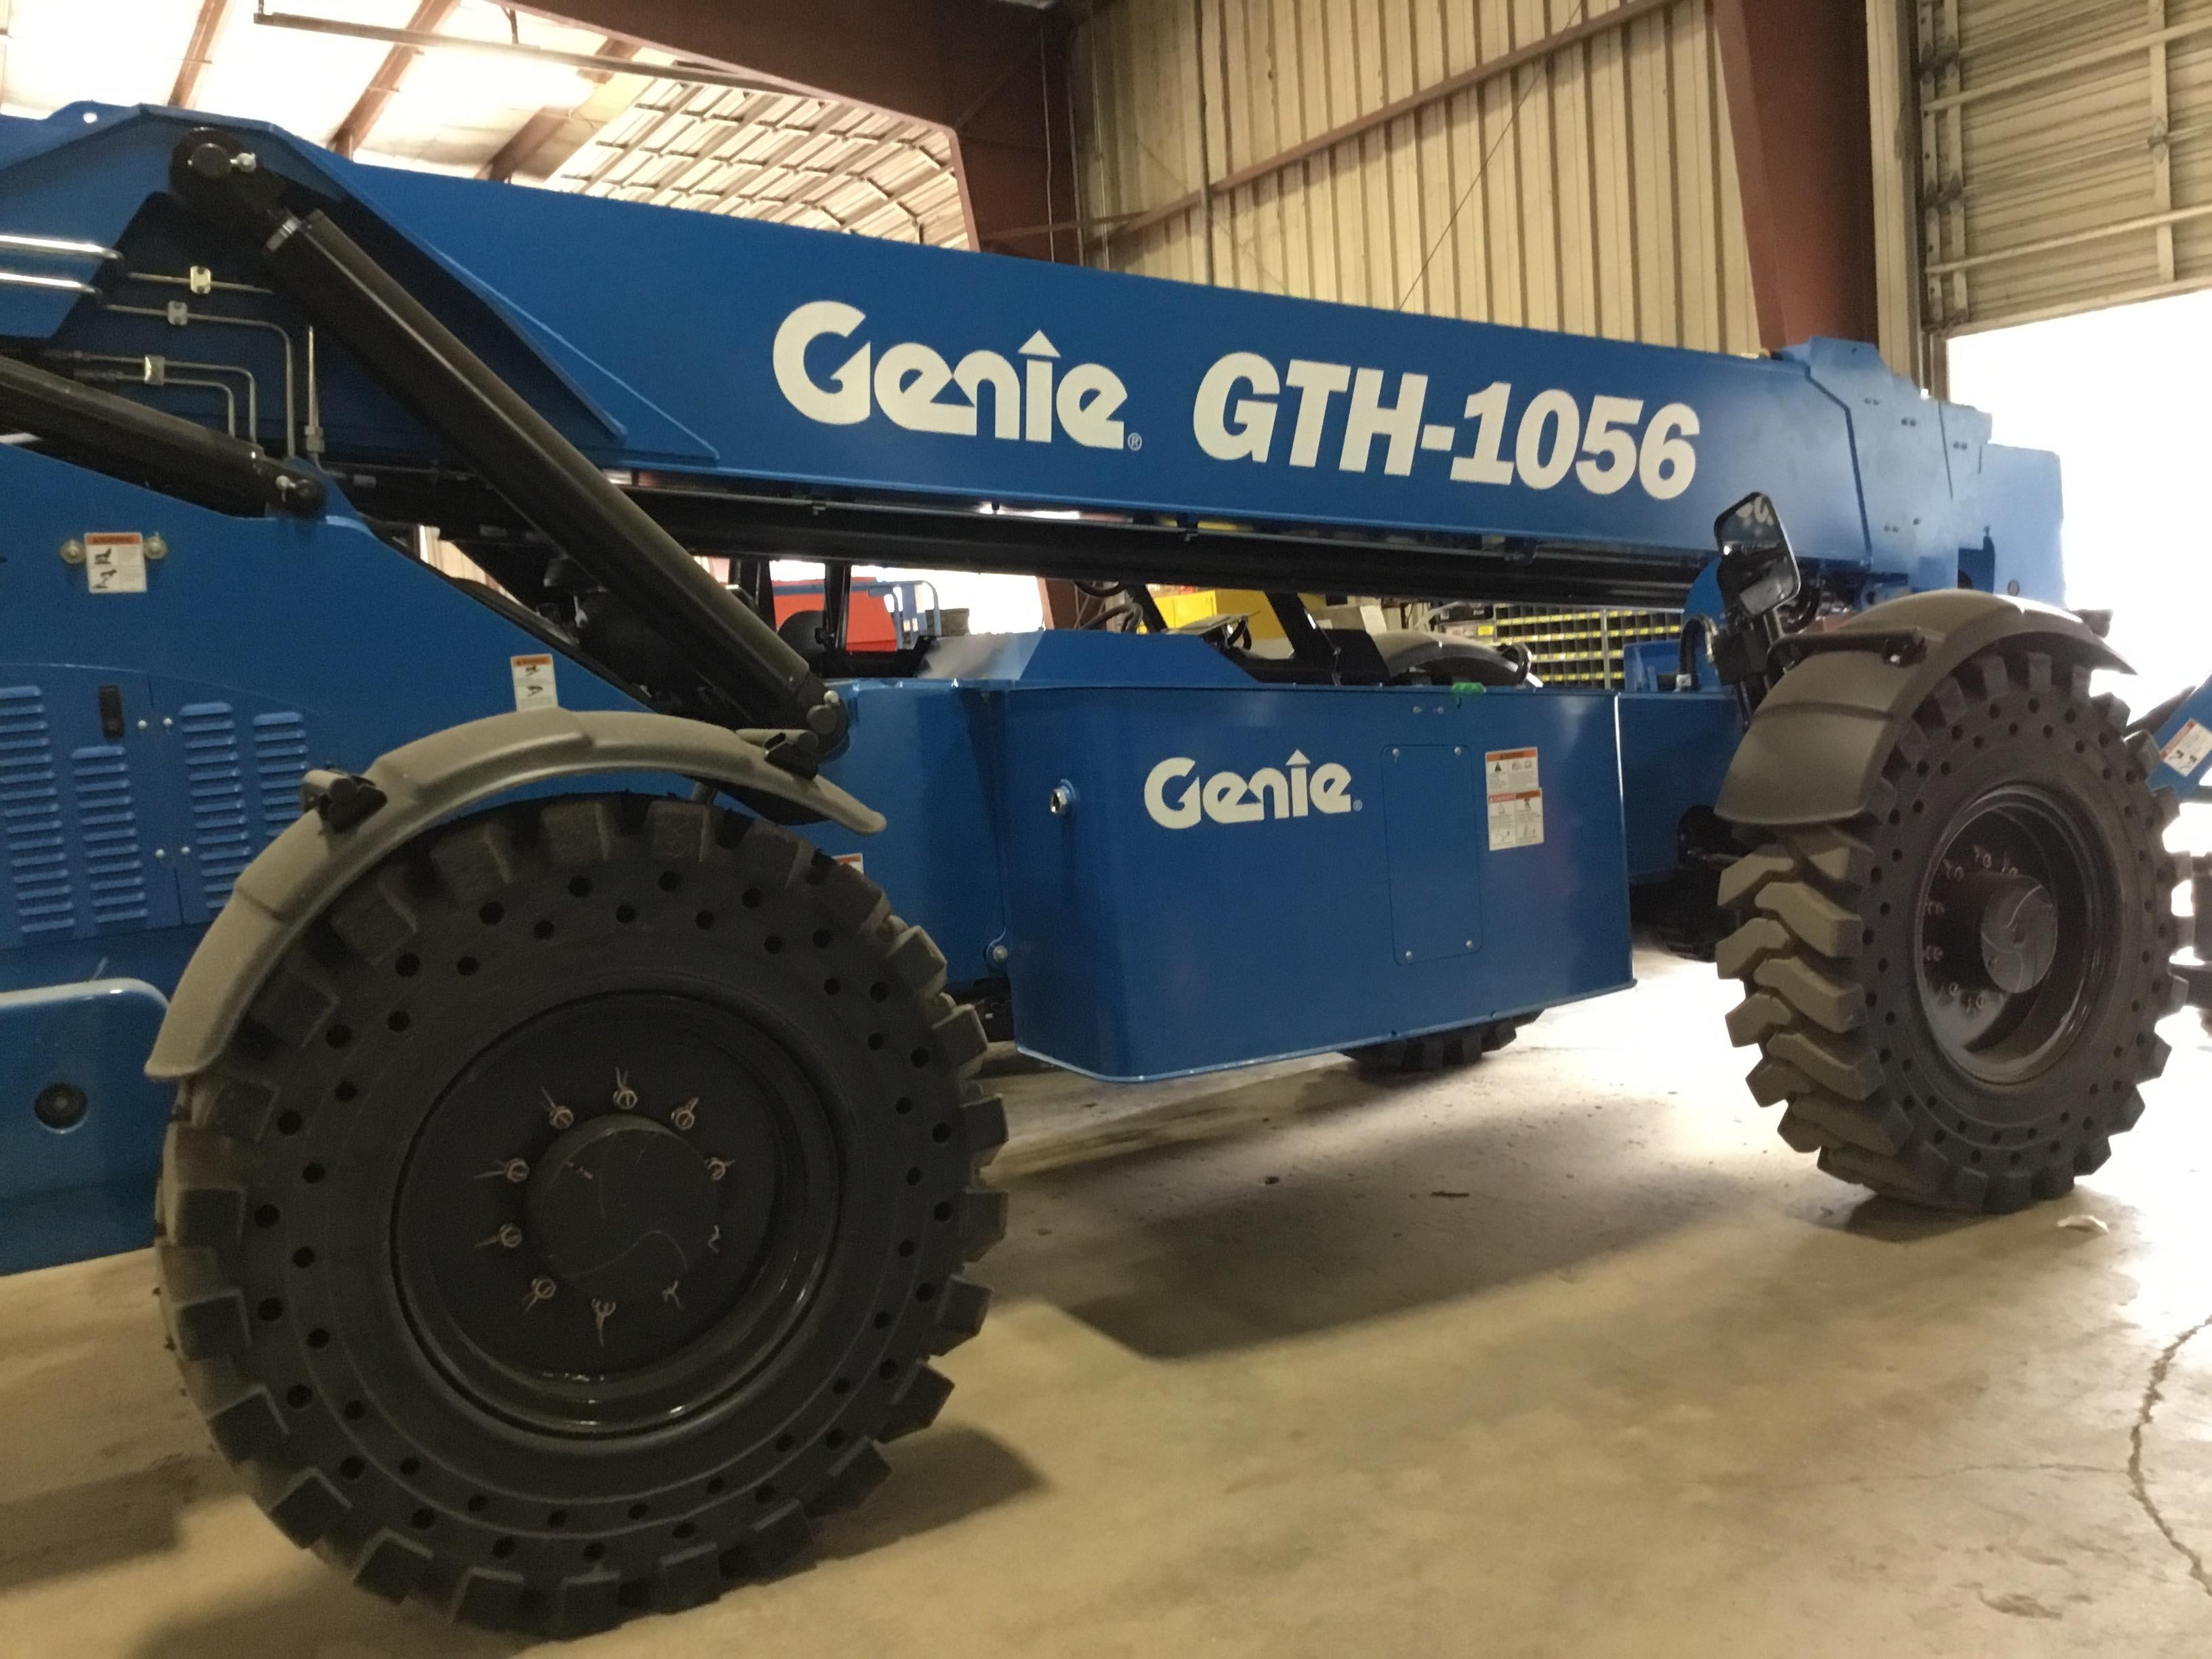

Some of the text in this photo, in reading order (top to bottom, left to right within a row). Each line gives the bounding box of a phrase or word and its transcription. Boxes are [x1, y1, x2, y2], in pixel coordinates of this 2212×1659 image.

[773, 300, 1700, 500] Genie GTH-1056
[1144, 750, 1353, 830] Genie
